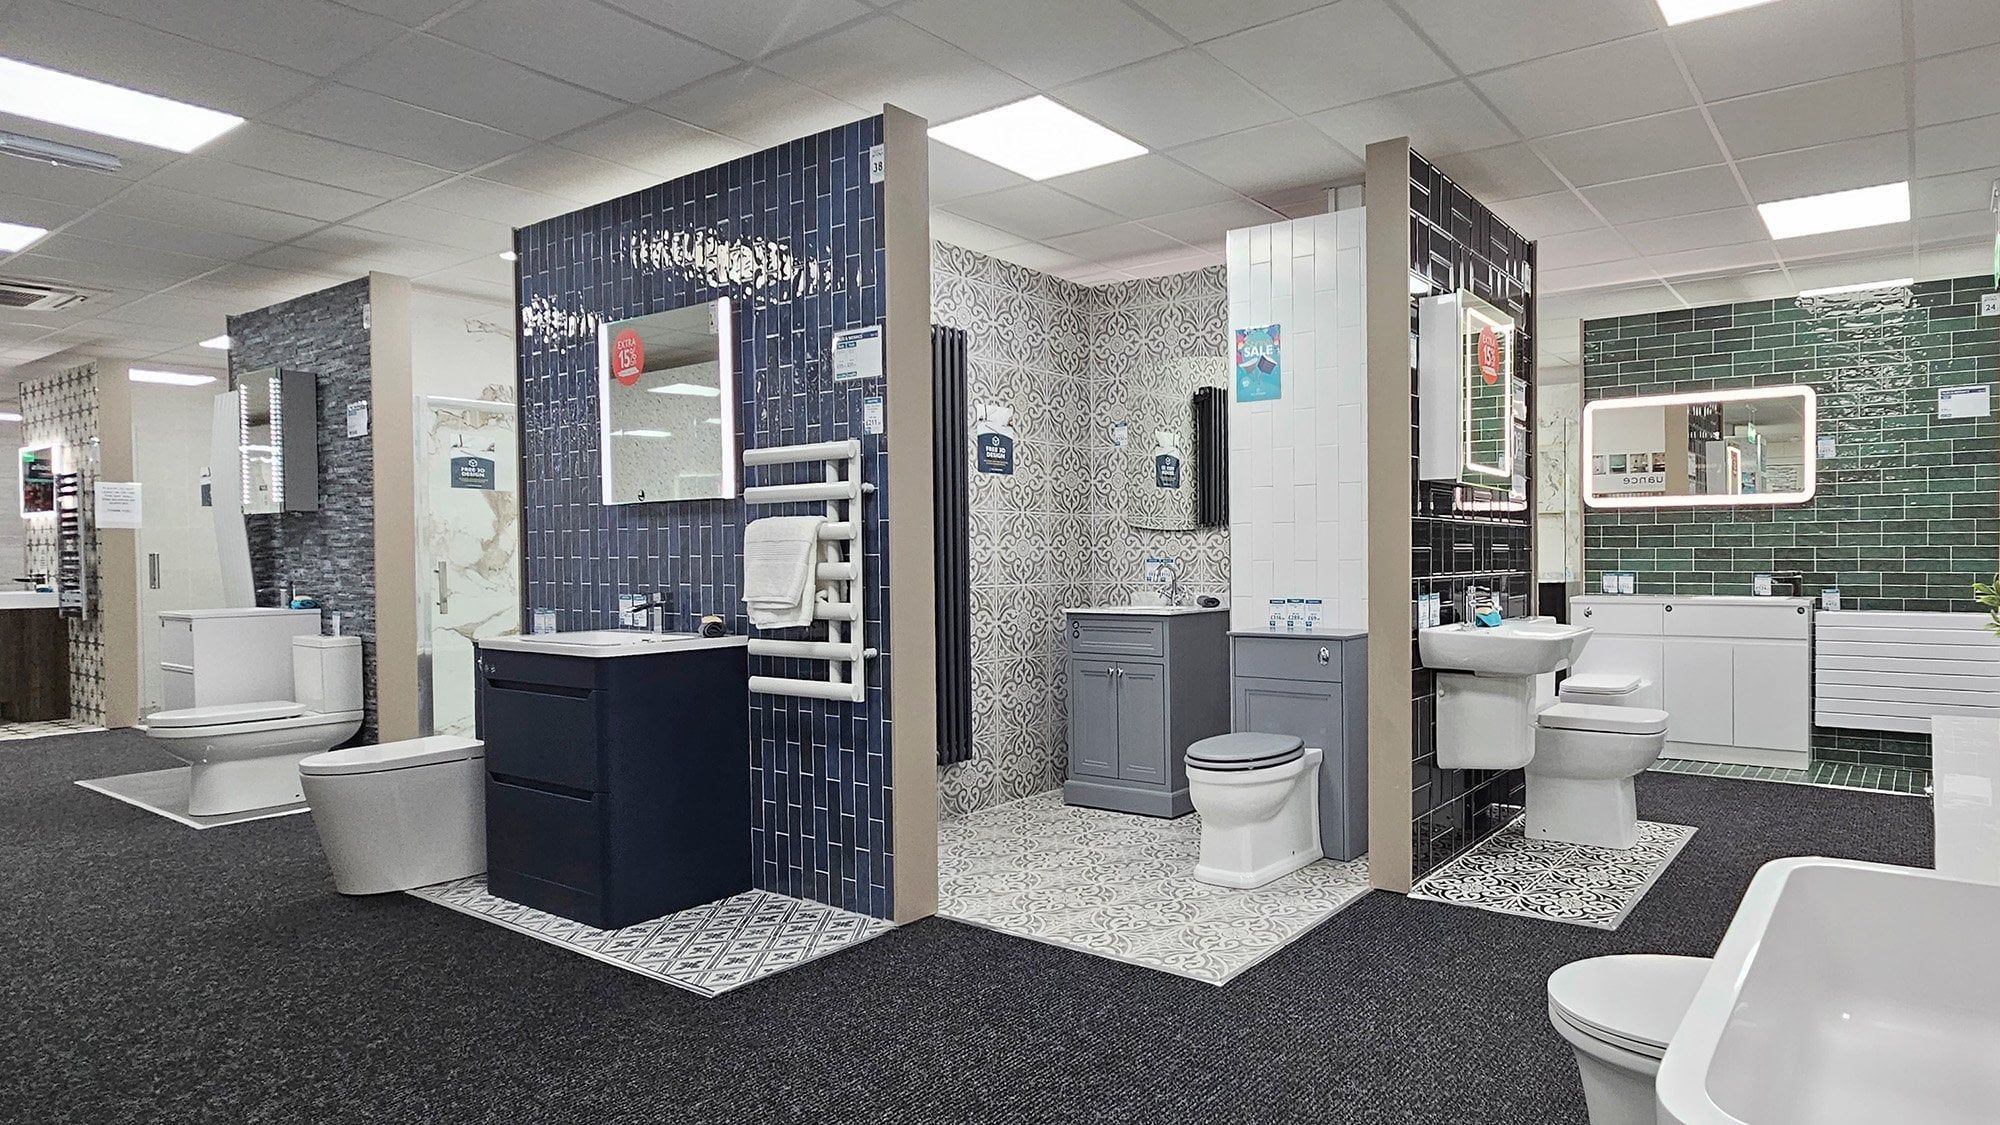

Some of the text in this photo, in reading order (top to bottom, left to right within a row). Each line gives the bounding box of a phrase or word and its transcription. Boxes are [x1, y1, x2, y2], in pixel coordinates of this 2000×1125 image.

[873, 161, 883, 173] 38
[1985, 303, 1996, 311] 24
[617, 339, 636, 350] EXTRA
[1244, 344, 1273, 358] SALE
